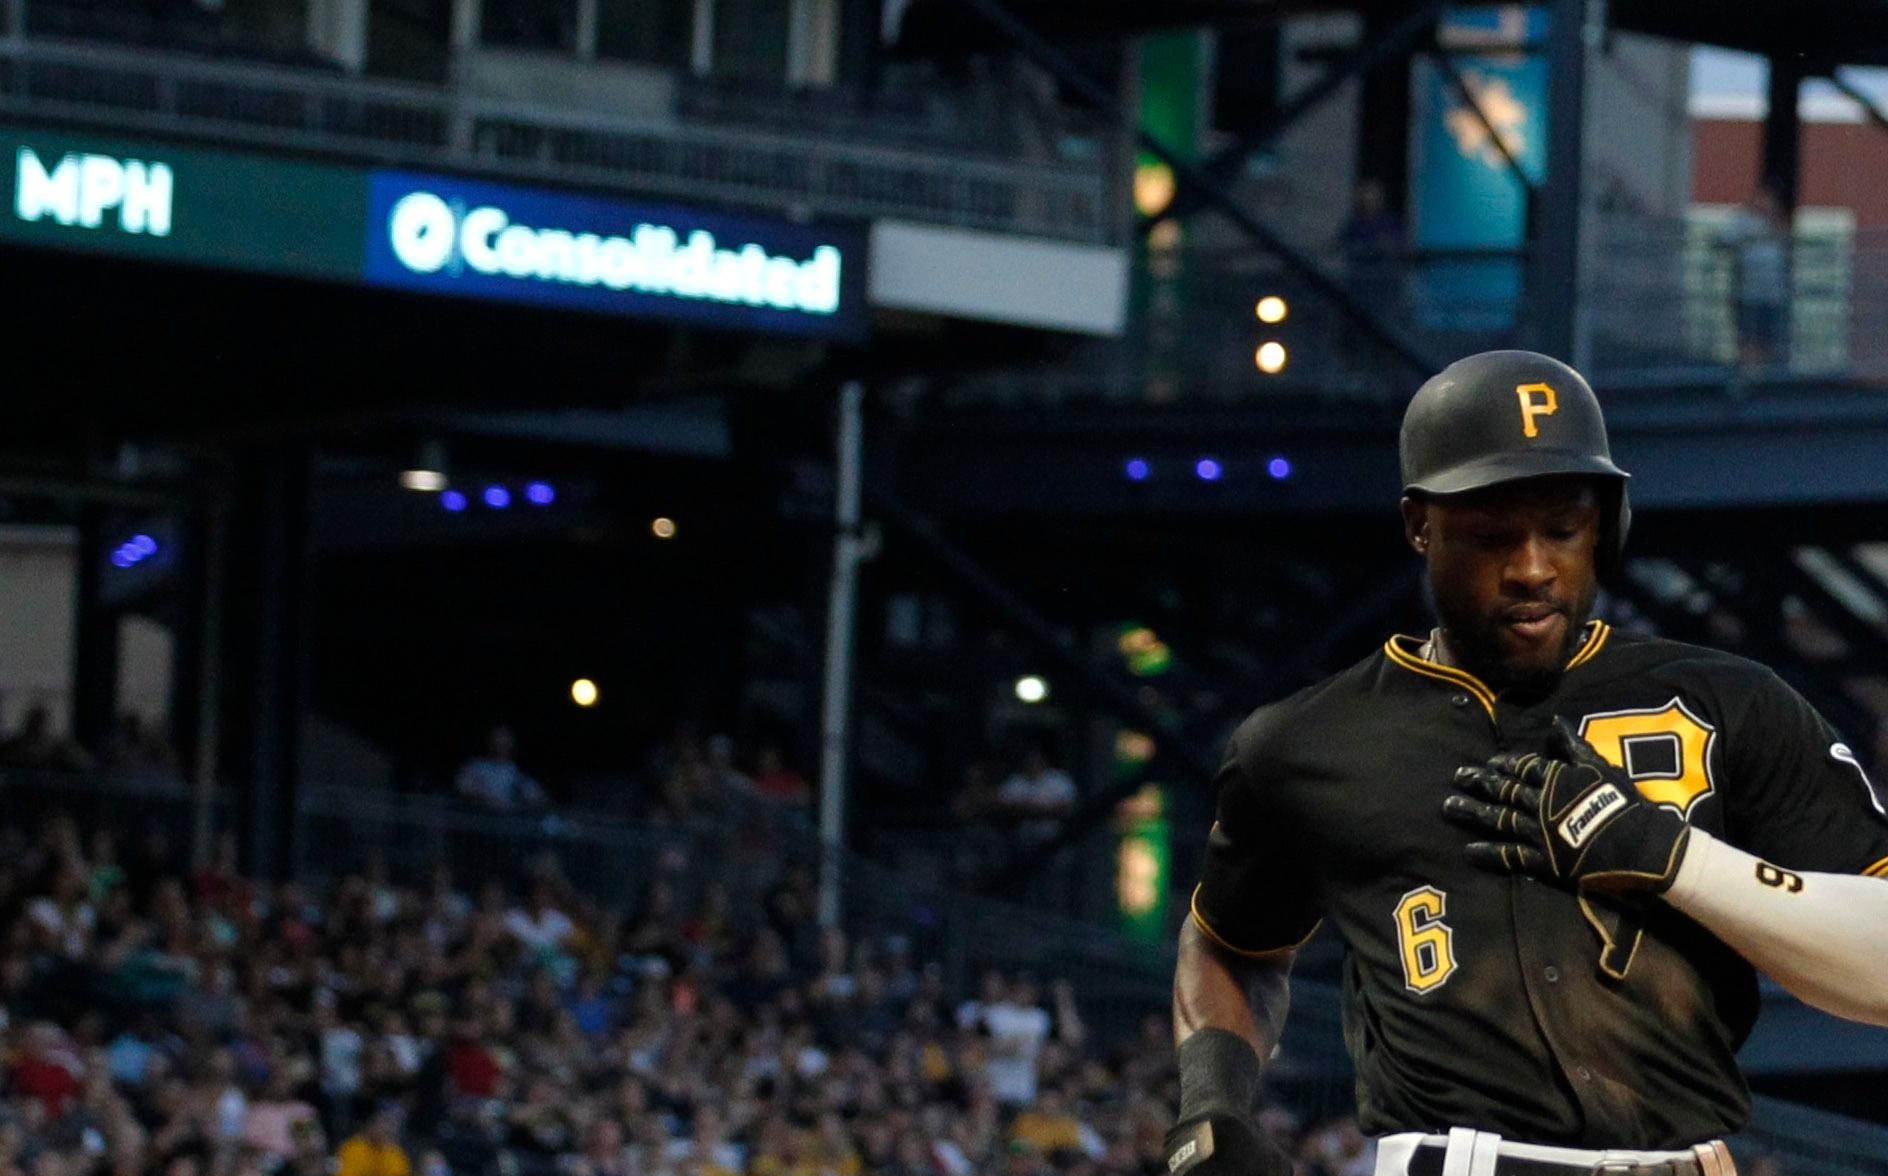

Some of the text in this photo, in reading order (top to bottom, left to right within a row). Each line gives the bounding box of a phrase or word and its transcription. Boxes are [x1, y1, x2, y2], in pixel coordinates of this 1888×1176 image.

[15, 145, 173, 236] MPH
[459, 207, 841, 314] Consolidated
[1516, 382, 1557, 437] P
[1392, 885, 1458, 995] 6
